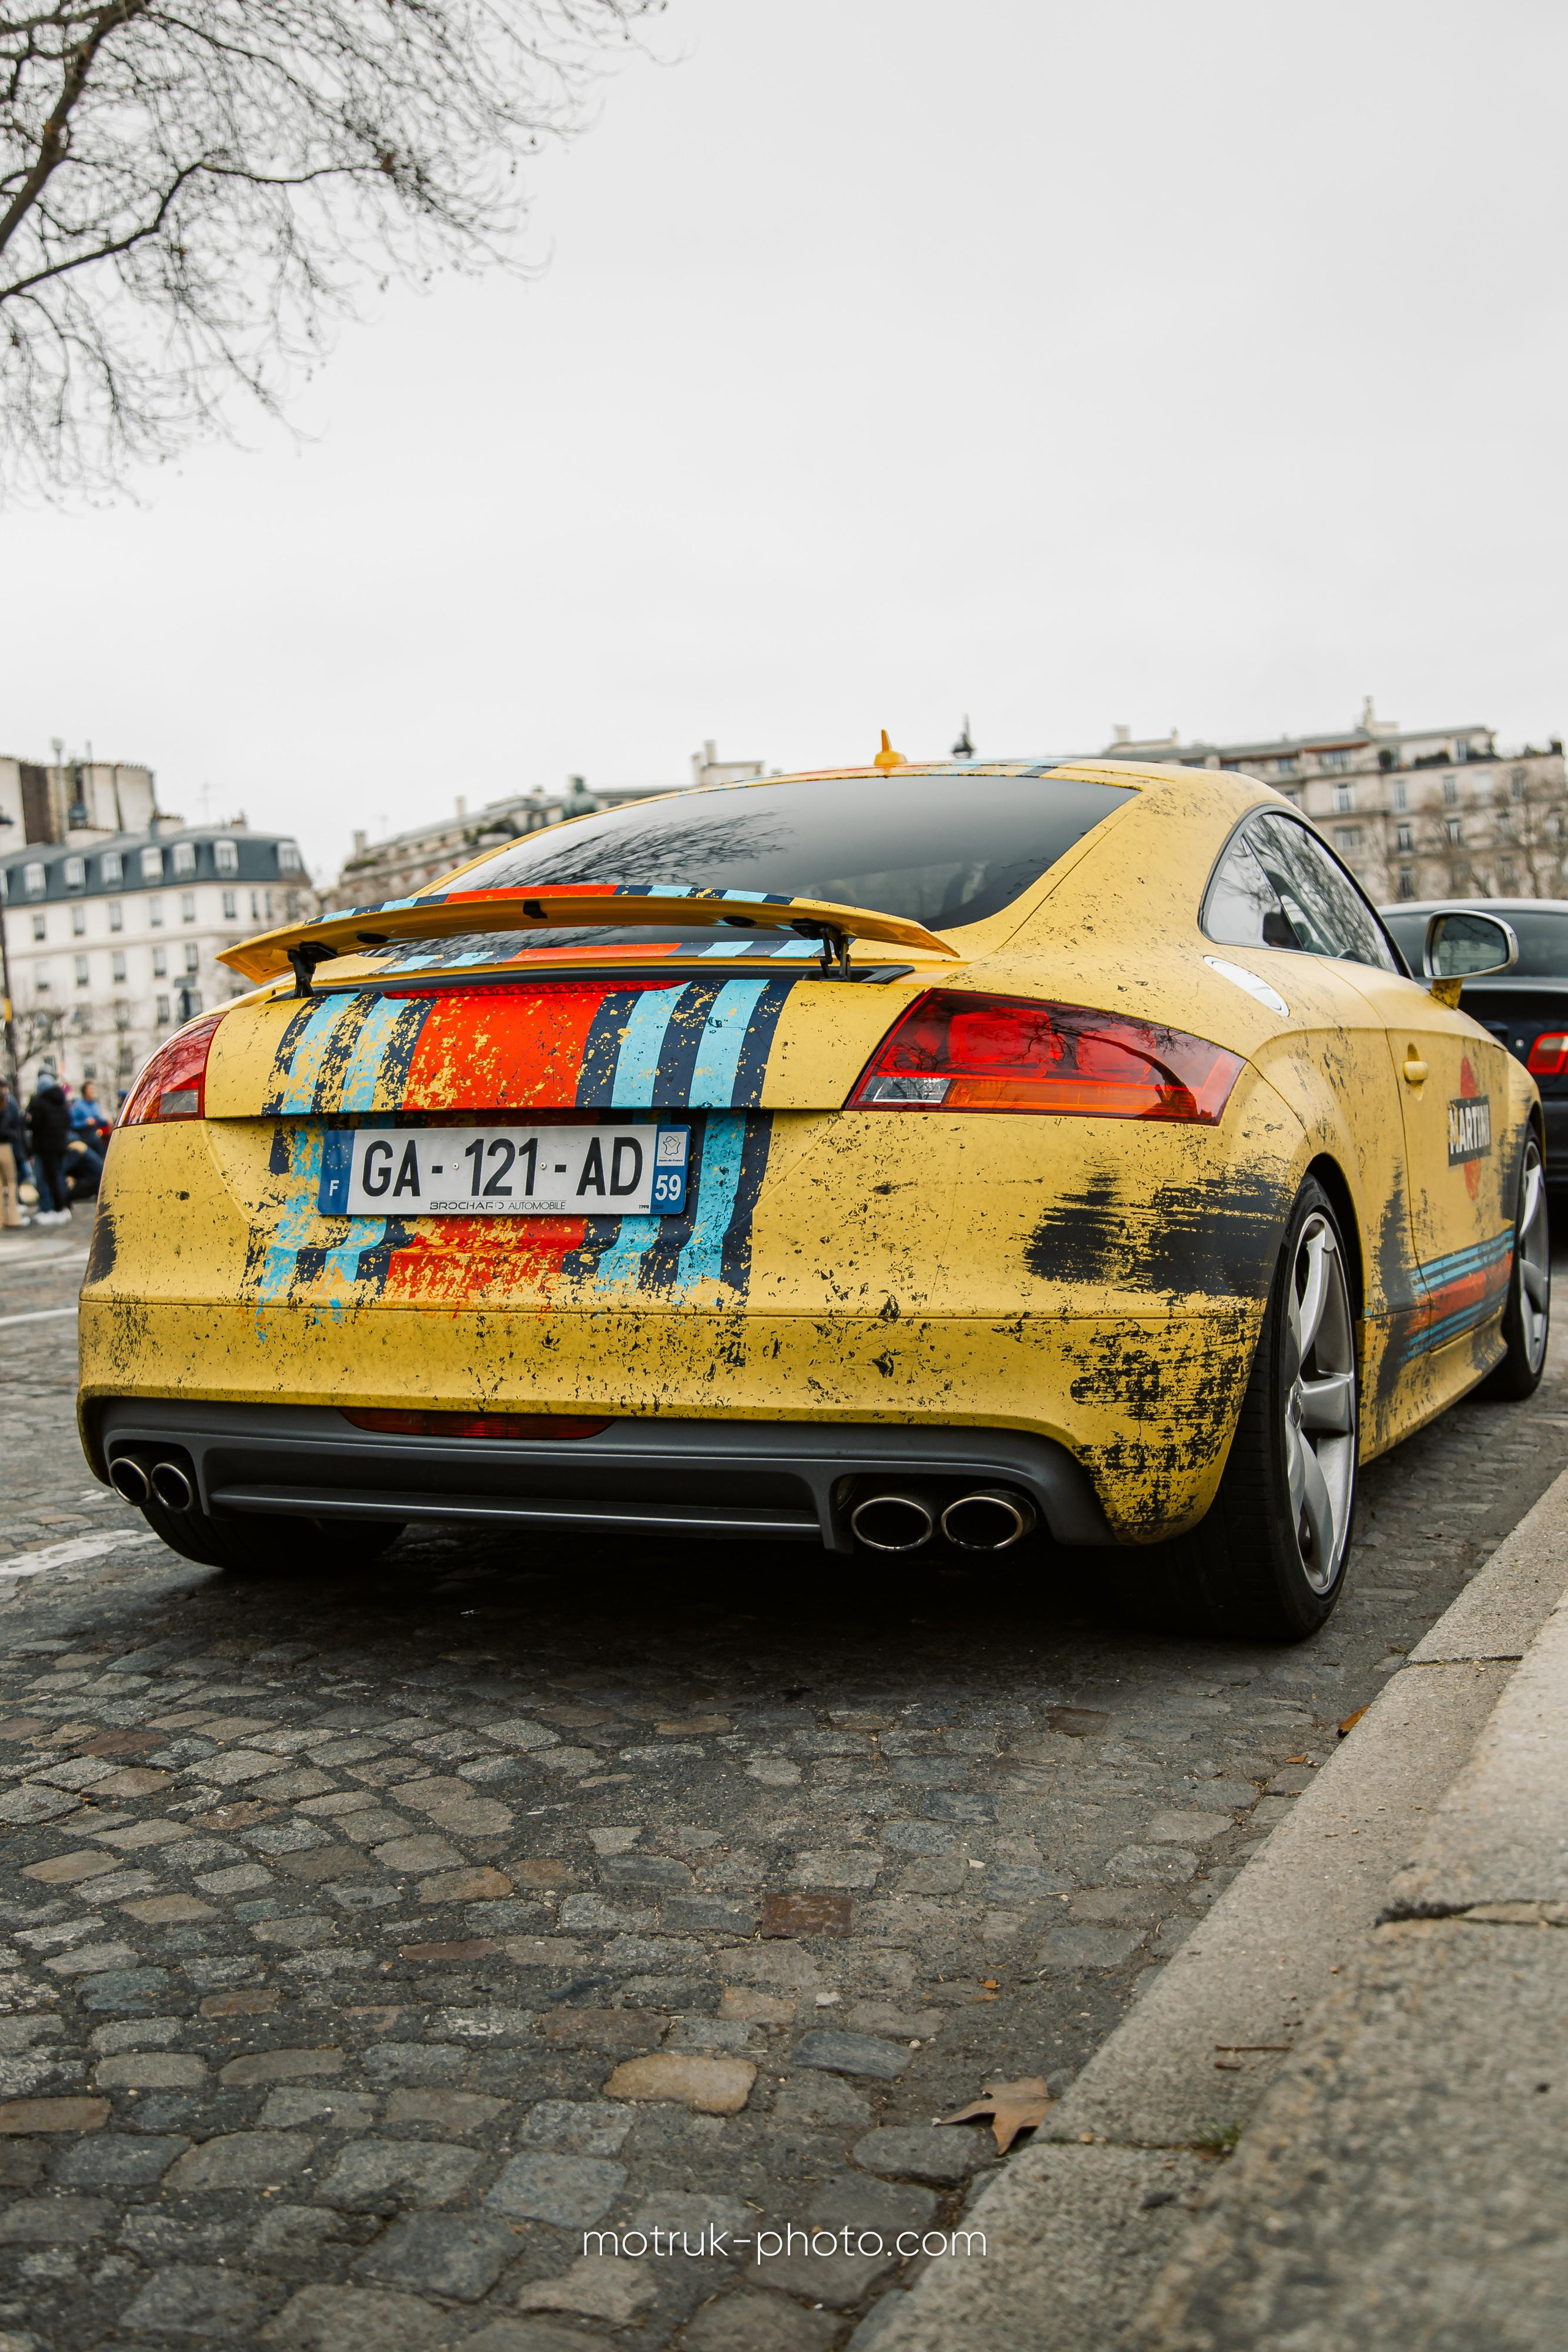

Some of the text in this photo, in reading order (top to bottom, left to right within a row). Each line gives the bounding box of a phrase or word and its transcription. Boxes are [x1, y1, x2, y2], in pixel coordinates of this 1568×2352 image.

[329, 1180, 339, 1197] F
[655, 1174, 682, 1201] 59
[508, 1201, 566, 1210] AUTOMOBILE
